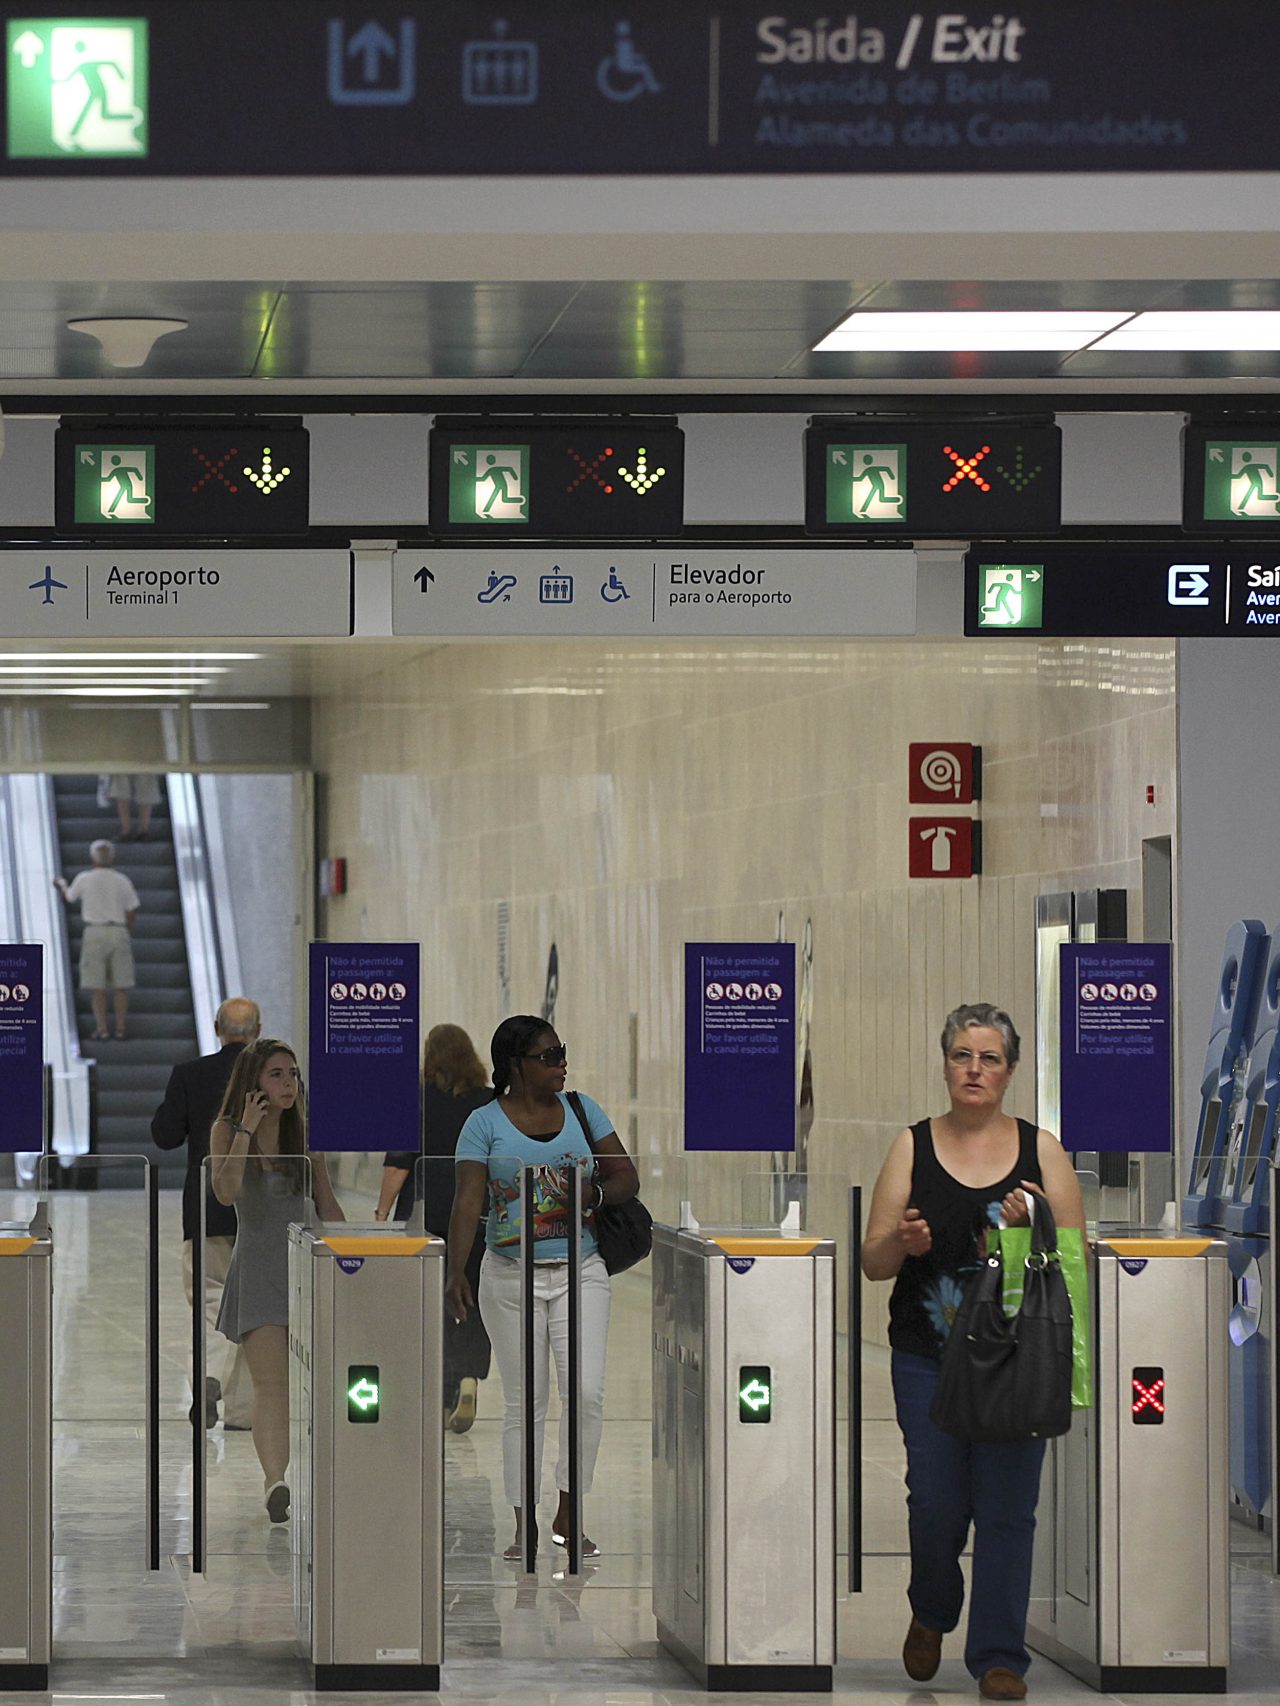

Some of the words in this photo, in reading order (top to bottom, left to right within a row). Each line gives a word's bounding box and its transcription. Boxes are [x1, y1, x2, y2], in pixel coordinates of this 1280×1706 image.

[756, 14, 886, 64] Saída
[895, 14, 924, 70] /
[931, 14, 1025, 63] Exit
[756, 74, 888, 103] Avenida
[896, 75, 938, 104] de
[945, 72, 1052, 104] Berlim
[756, 114, 895, 146] Alameda
[903, 114, 959, 146] das
[966, 112, 1188, 147] Comunidades
[106, 565, 220, 590] Aeroporto
[669, 563, 766, 586] Elevador
[106, 590, 168, 605] Terminal
[171, 590, 178, 605] 1
[669, 592, 701, 608] para
[704, 593, 714, 605] o
[716, 589, 792, 608] Aeroporto
[330, 957, 348, 965] Não
[351, 957, 355, 965] é
[359, 957, 403, 966] permitida
[706, 957, 724, 965] Não
[727, 957, 731, 965] é
[735, 957, 779, 966] permitida
[338, 970, 384, 978] passagem
[714, 970, 760, 978] passagem
[330, 1034, 346, 1042] Por
[349, 1034, 371, 1042] favor
[374, 1034, 402, 1042] utilize
[706, 1034, 722, 1042] Por
[725, 1034, 747, 1042] favor
[750, 1034, 778, 1042] utilize
[339, 1045, 363, 1054] canal
[366, 1045, 403, 1055] especial
[715, 1045, 739, 1054] canal
[741, 1045, 779, 1055] especial
